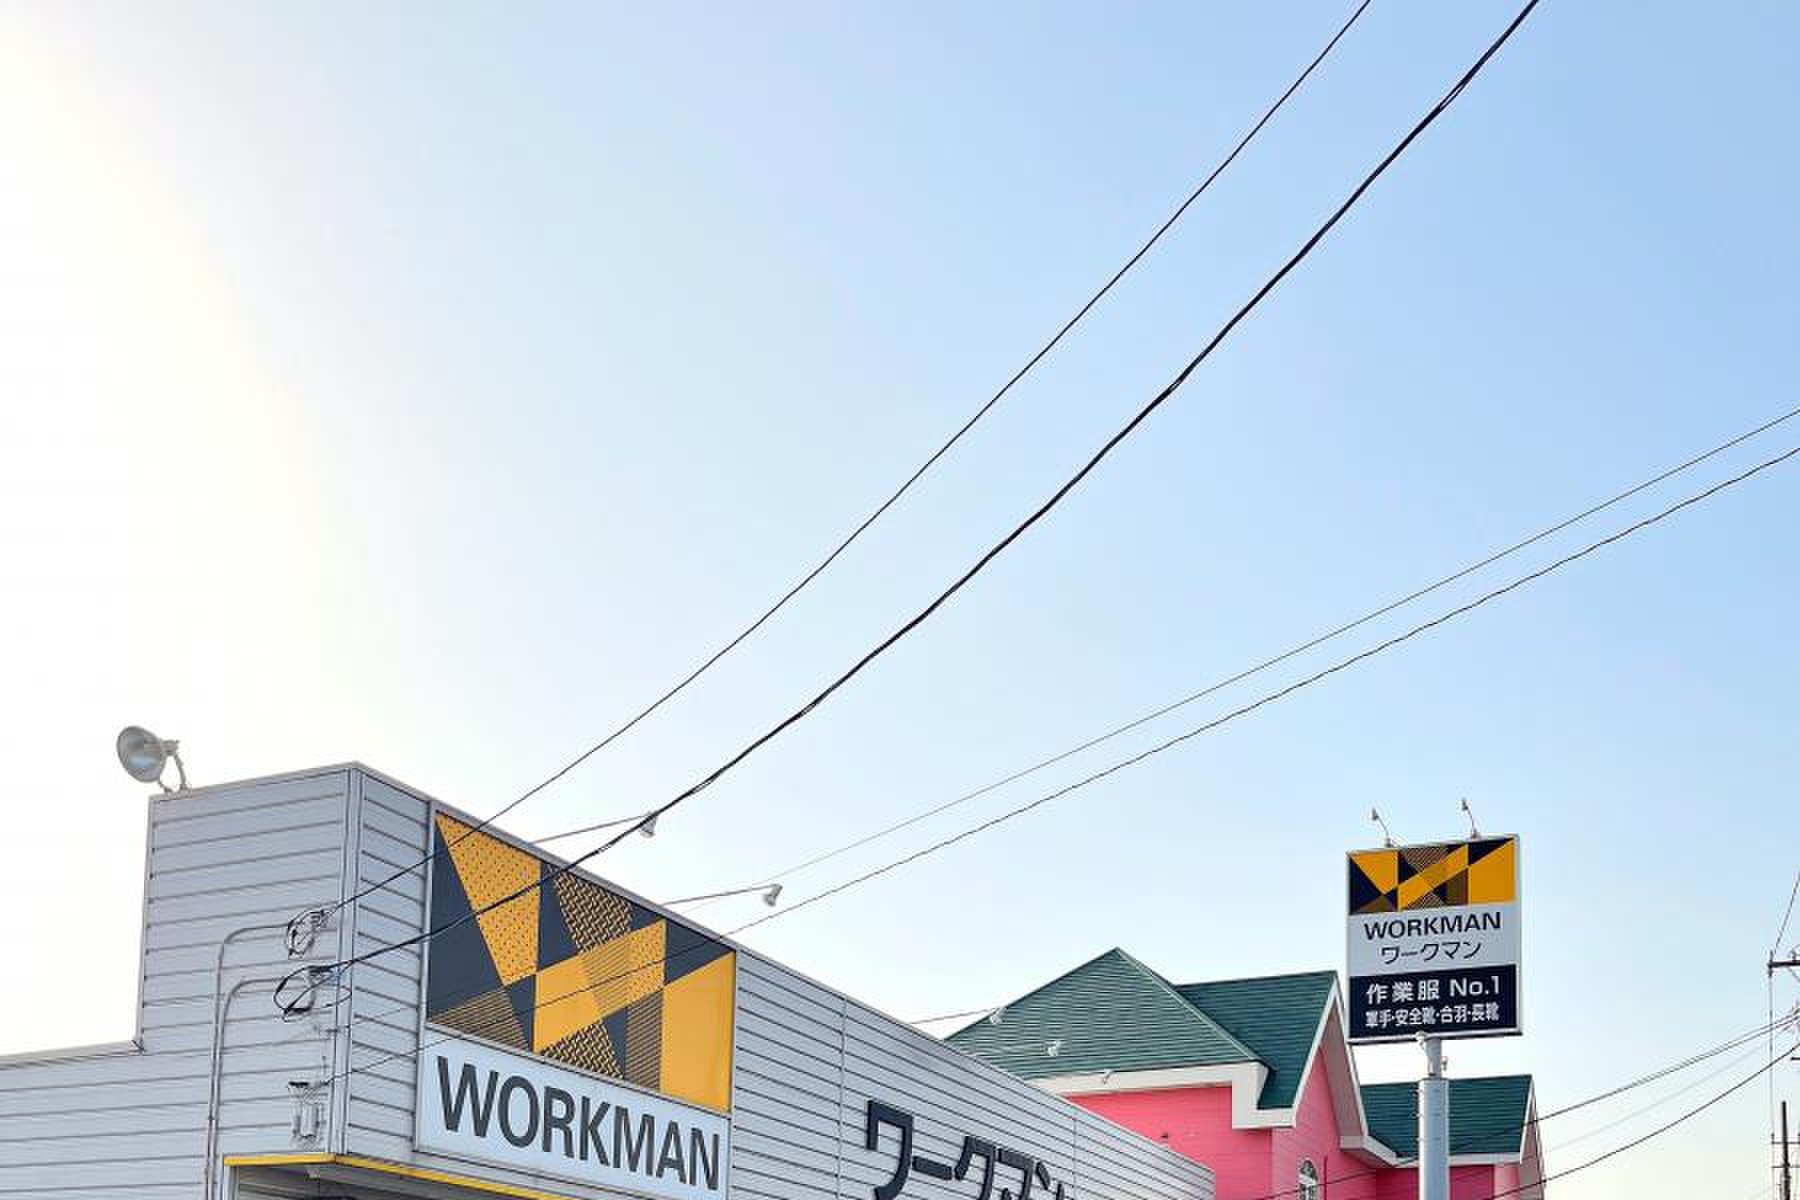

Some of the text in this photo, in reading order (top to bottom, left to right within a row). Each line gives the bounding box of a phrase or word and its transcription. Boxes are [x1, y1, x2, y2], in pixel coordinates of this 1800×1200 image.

[1364, 911, 1501, 940] WORKMAN
[1381, 941, 1482, 964] ワークマン
[1366, 975, 1500, 1005] 作業服 No.1
[436, 1055, 720, 1190] WORKMAN
